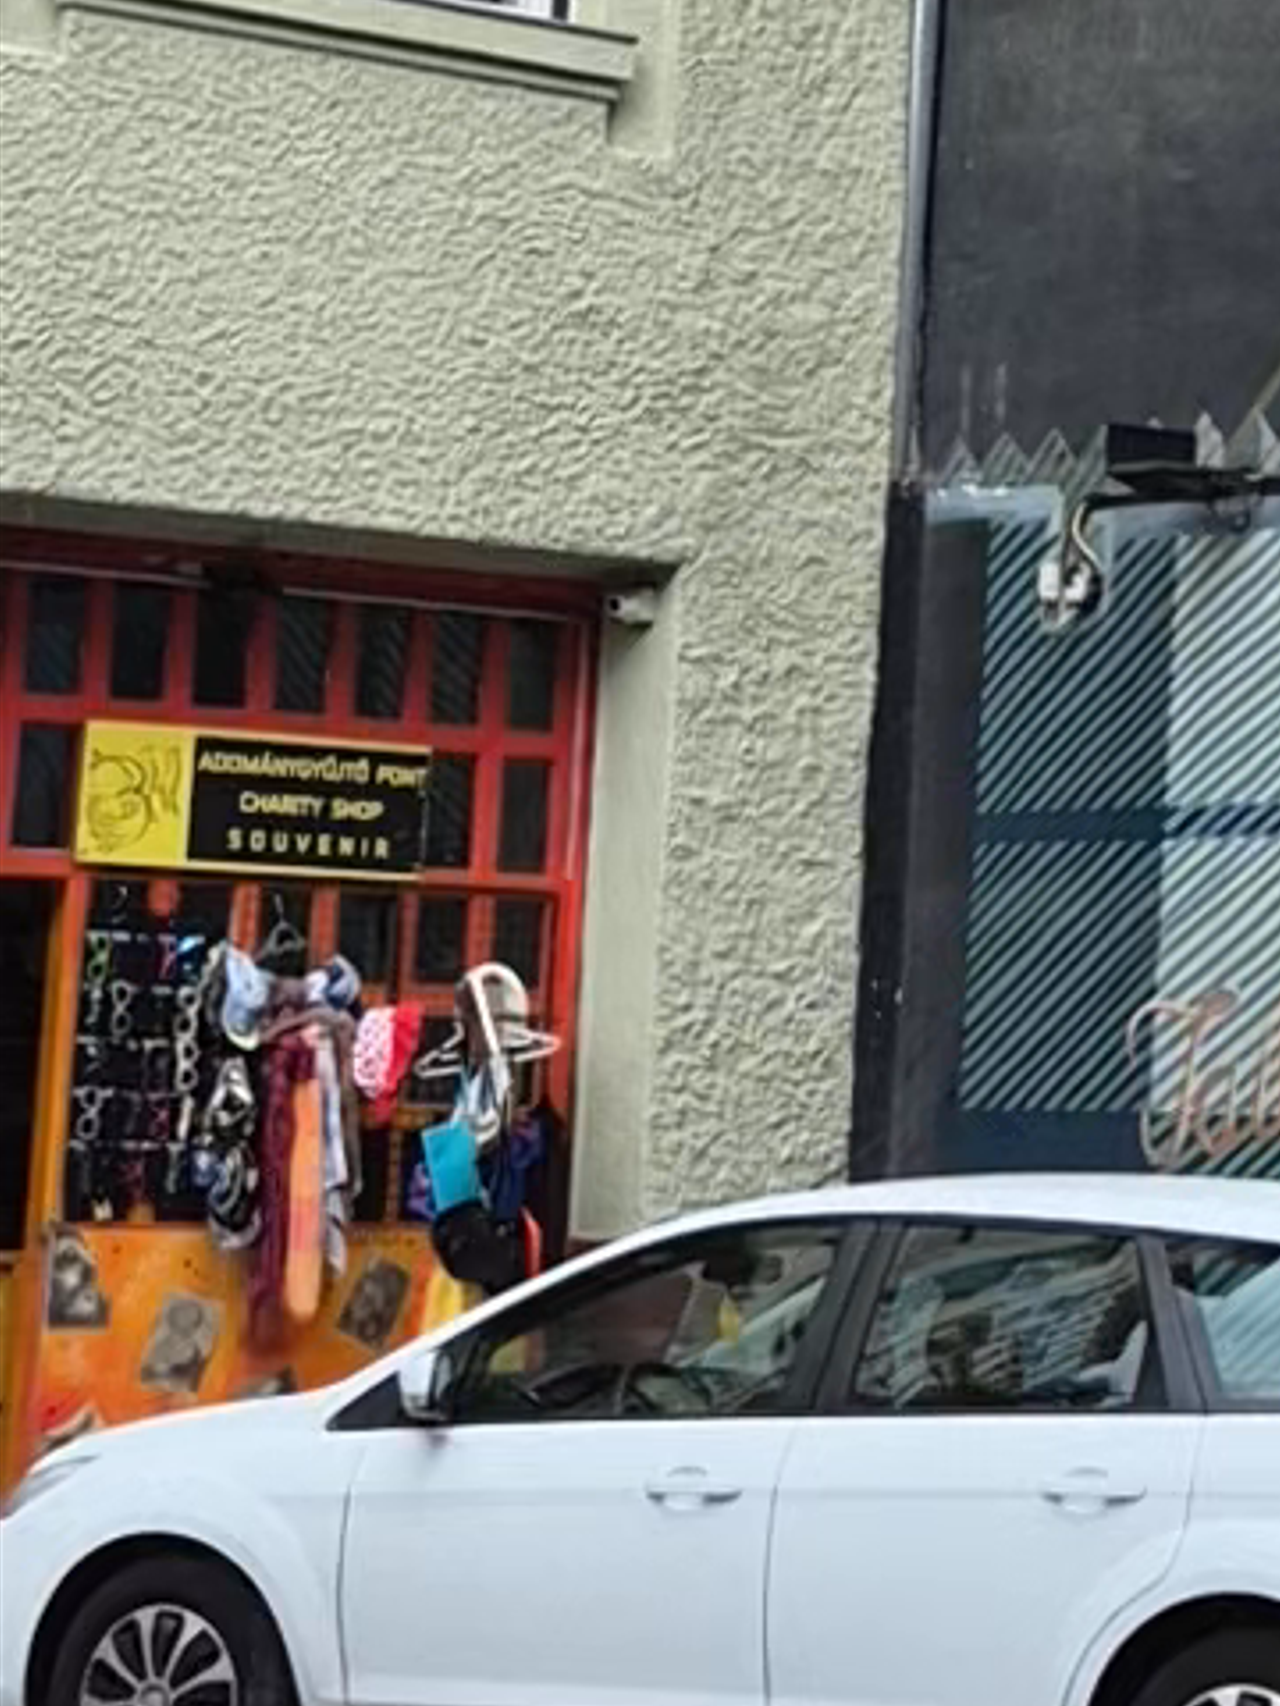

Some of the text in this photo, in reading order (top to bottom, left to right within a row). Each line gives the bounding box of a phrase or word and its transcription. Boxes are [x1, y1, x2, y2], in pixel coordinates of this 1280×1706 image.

[375, 763, 428, 787] PONT
[239, 789, 384, 822] CHARITY SHOP
[227, 825, 390, 860] SOUVENIR
